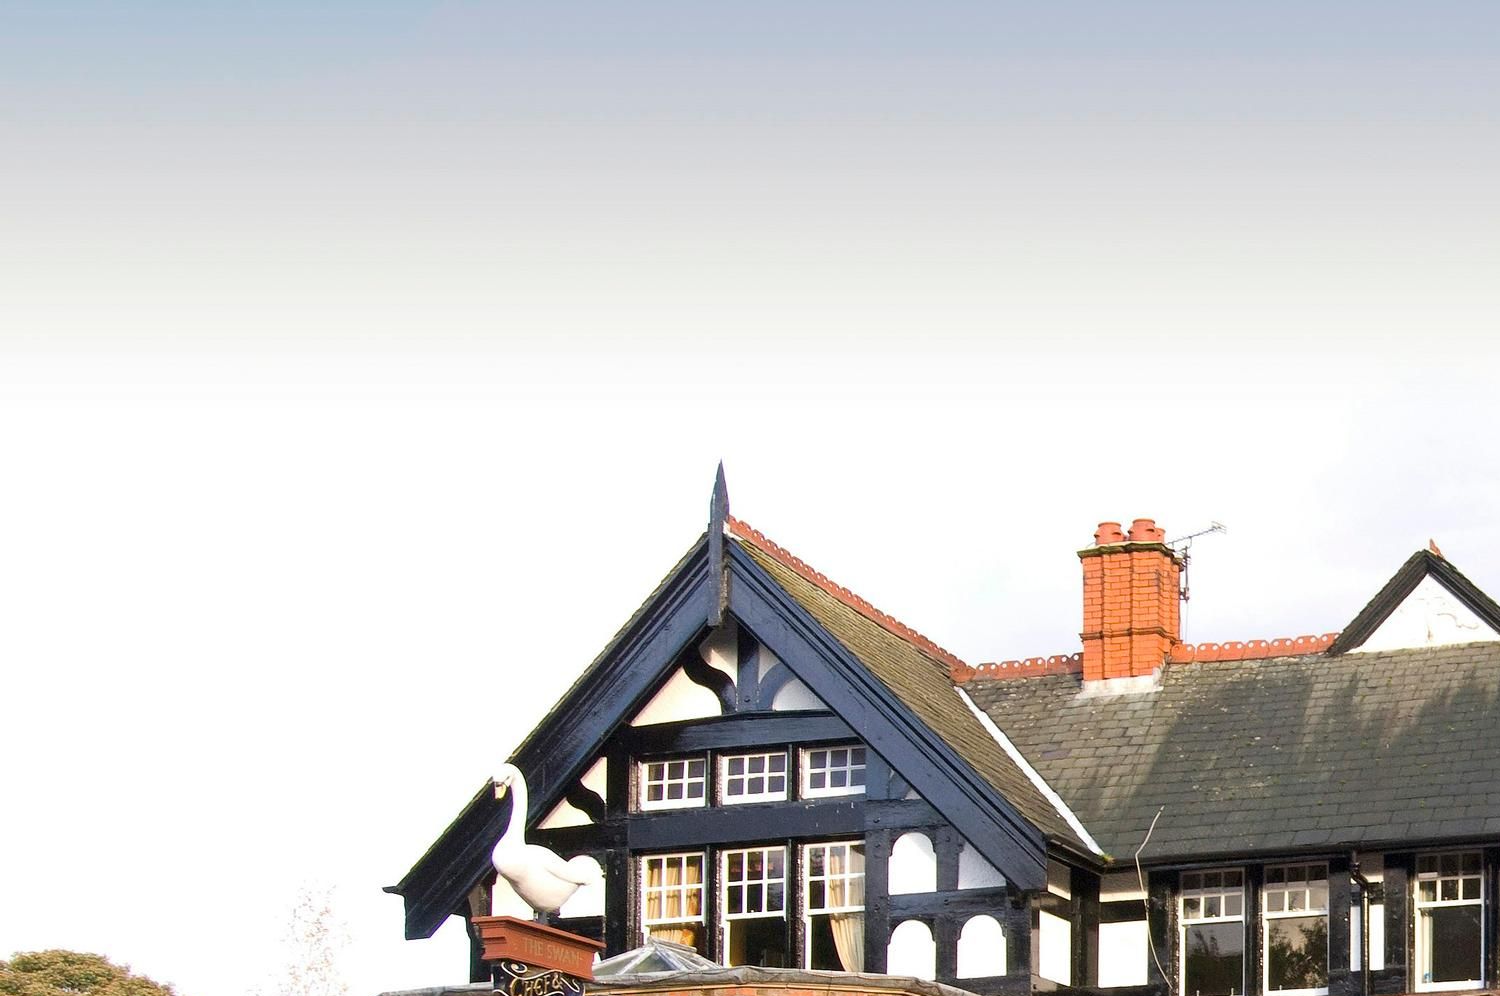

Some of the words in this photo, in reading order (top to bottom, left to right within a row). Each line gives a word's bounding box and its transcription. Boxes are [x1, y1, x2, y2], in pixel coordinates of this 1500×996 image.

[524, 936, 544, 957] THE
[546, 944, 580, 964] SWAN
[552, 972, 563, 989] &
